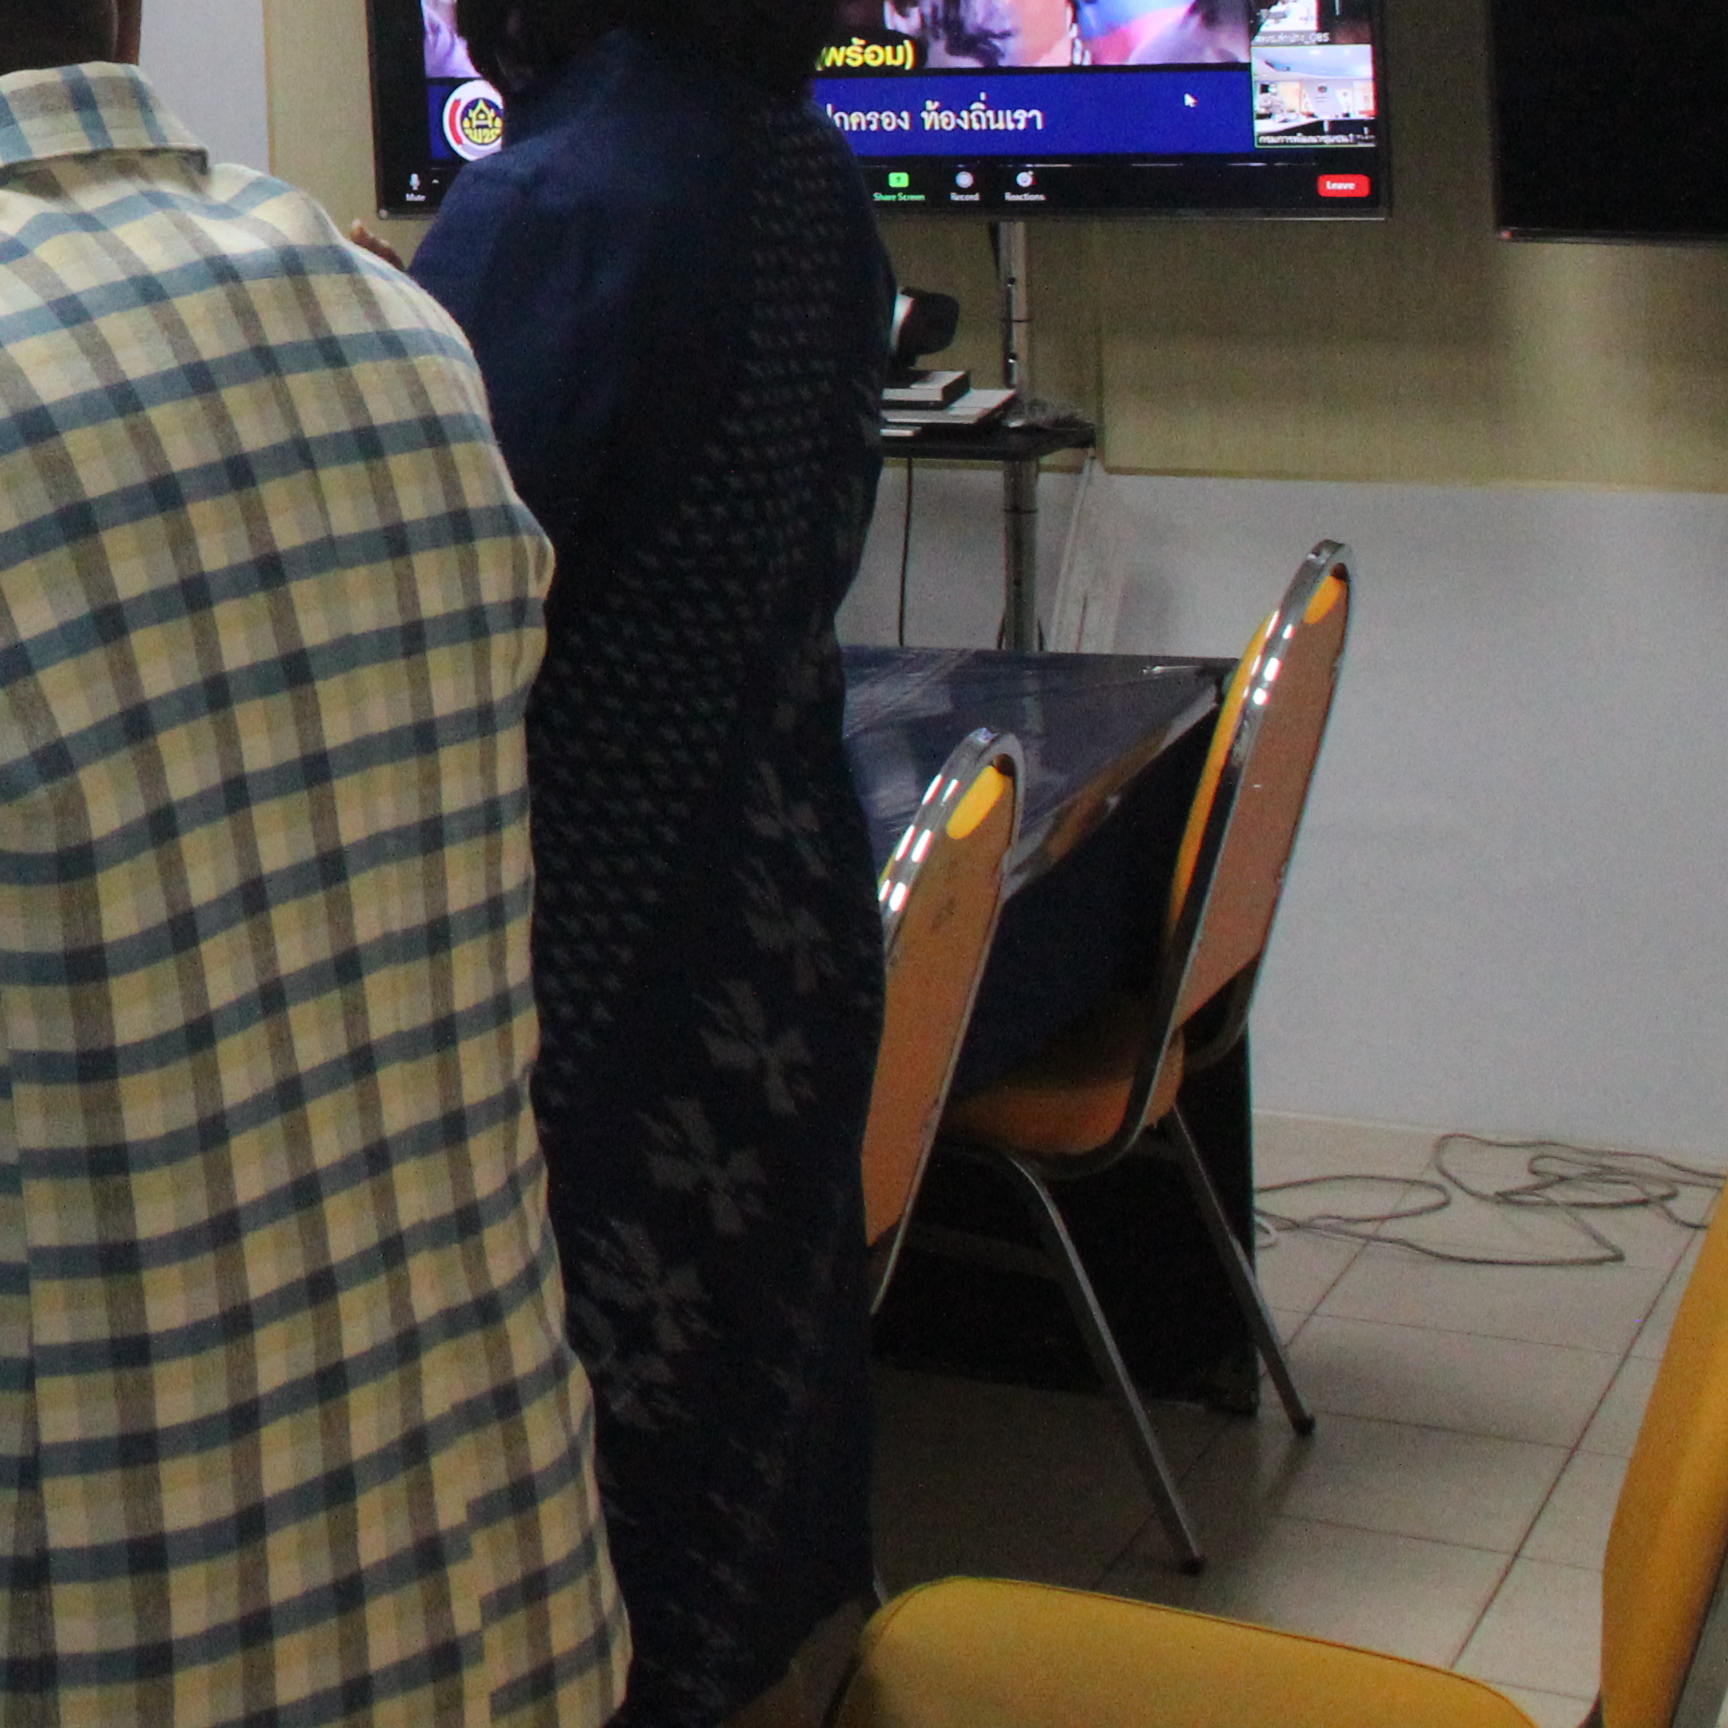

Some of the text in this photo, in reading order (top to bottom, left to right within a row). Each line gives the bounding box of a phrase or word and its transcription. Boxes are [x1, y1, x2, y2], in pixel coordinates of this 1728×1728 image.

[920, 92, 1043, 131] ท้องถิ่นเรา
[1325, 180, 1356, 190] Leave
[405, 193, 426, 202] Mute
[873, 191, 926, 202] Share Screen
[950, 191, 980, 202] Record
[1004, 191, 1047, 202] Reactions
